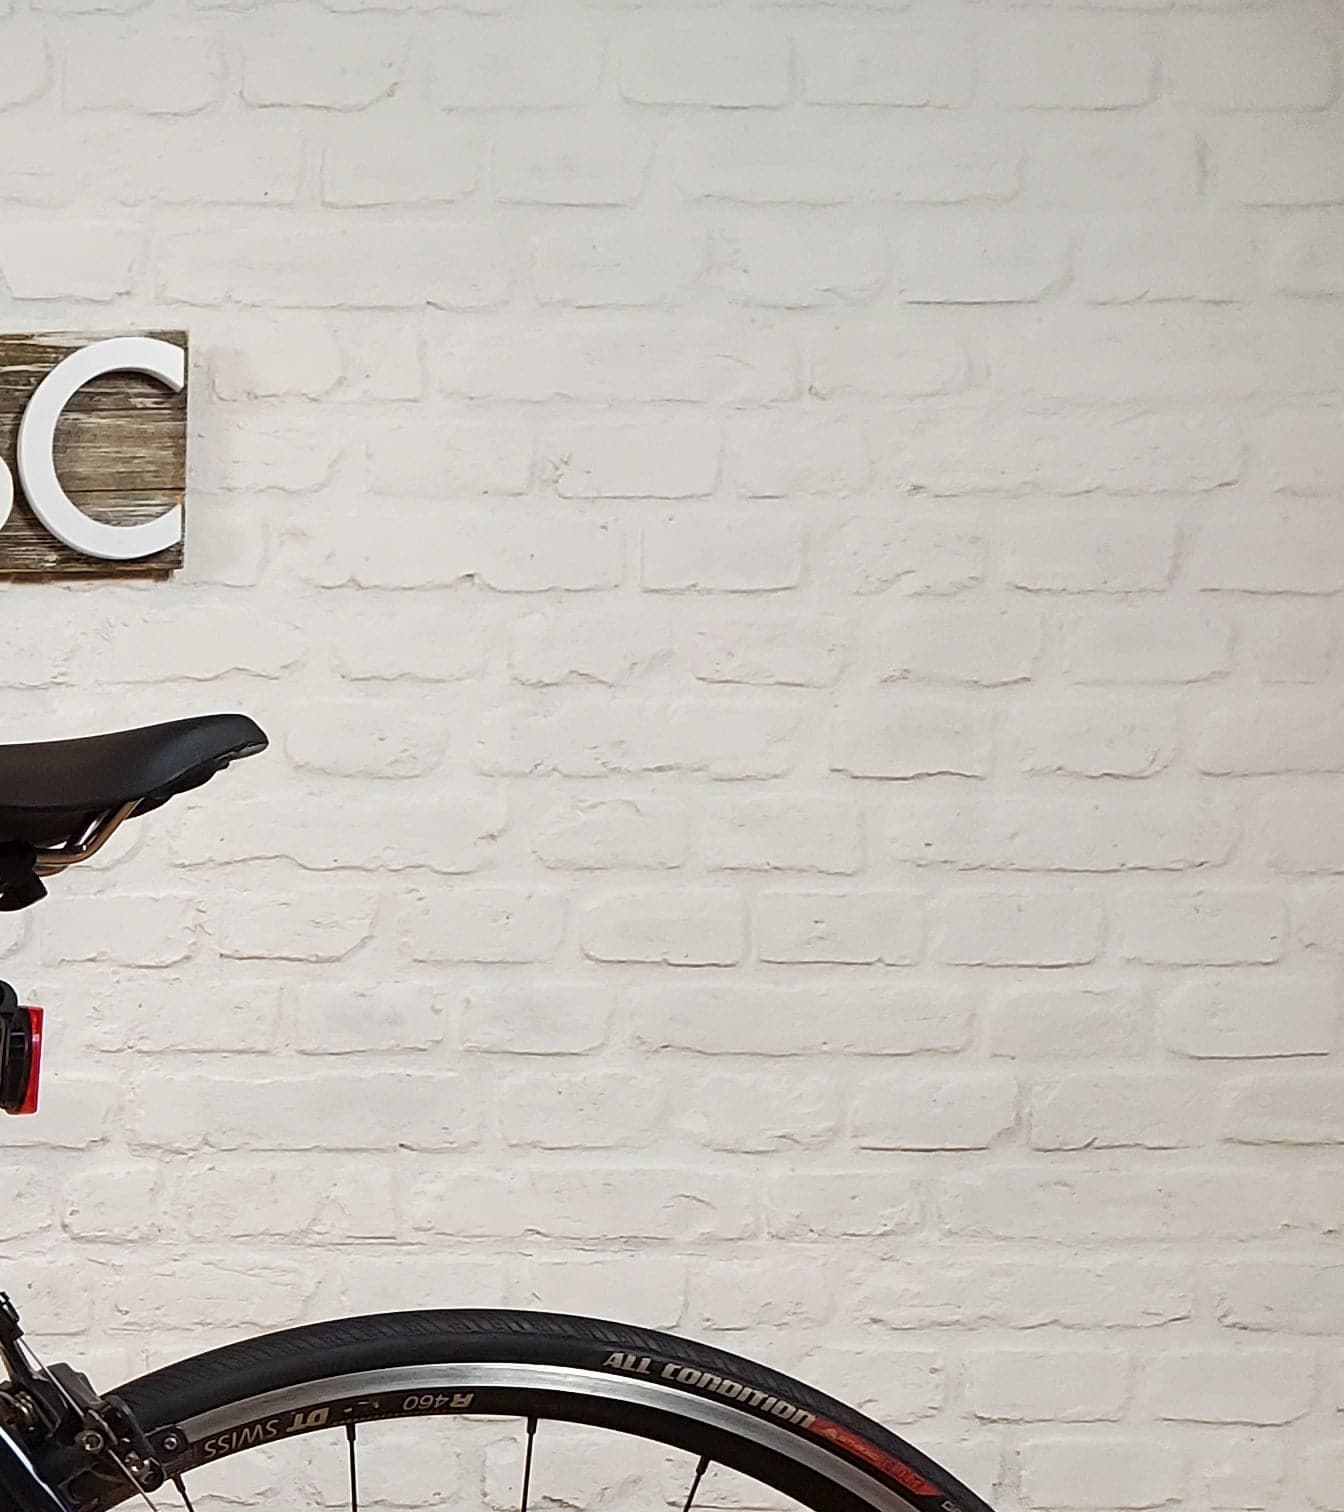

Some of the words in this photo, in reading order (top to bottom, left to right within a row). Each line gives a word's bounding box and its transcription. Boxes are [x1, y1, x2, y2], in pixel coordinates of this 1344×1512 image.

[603, 1351, 651, 1375] ALL
[660, 1362, 816, 1429] CONDITION
[204, 1419, 280, 1459] SWISS
[286, 1408, 329, 1433] DT
